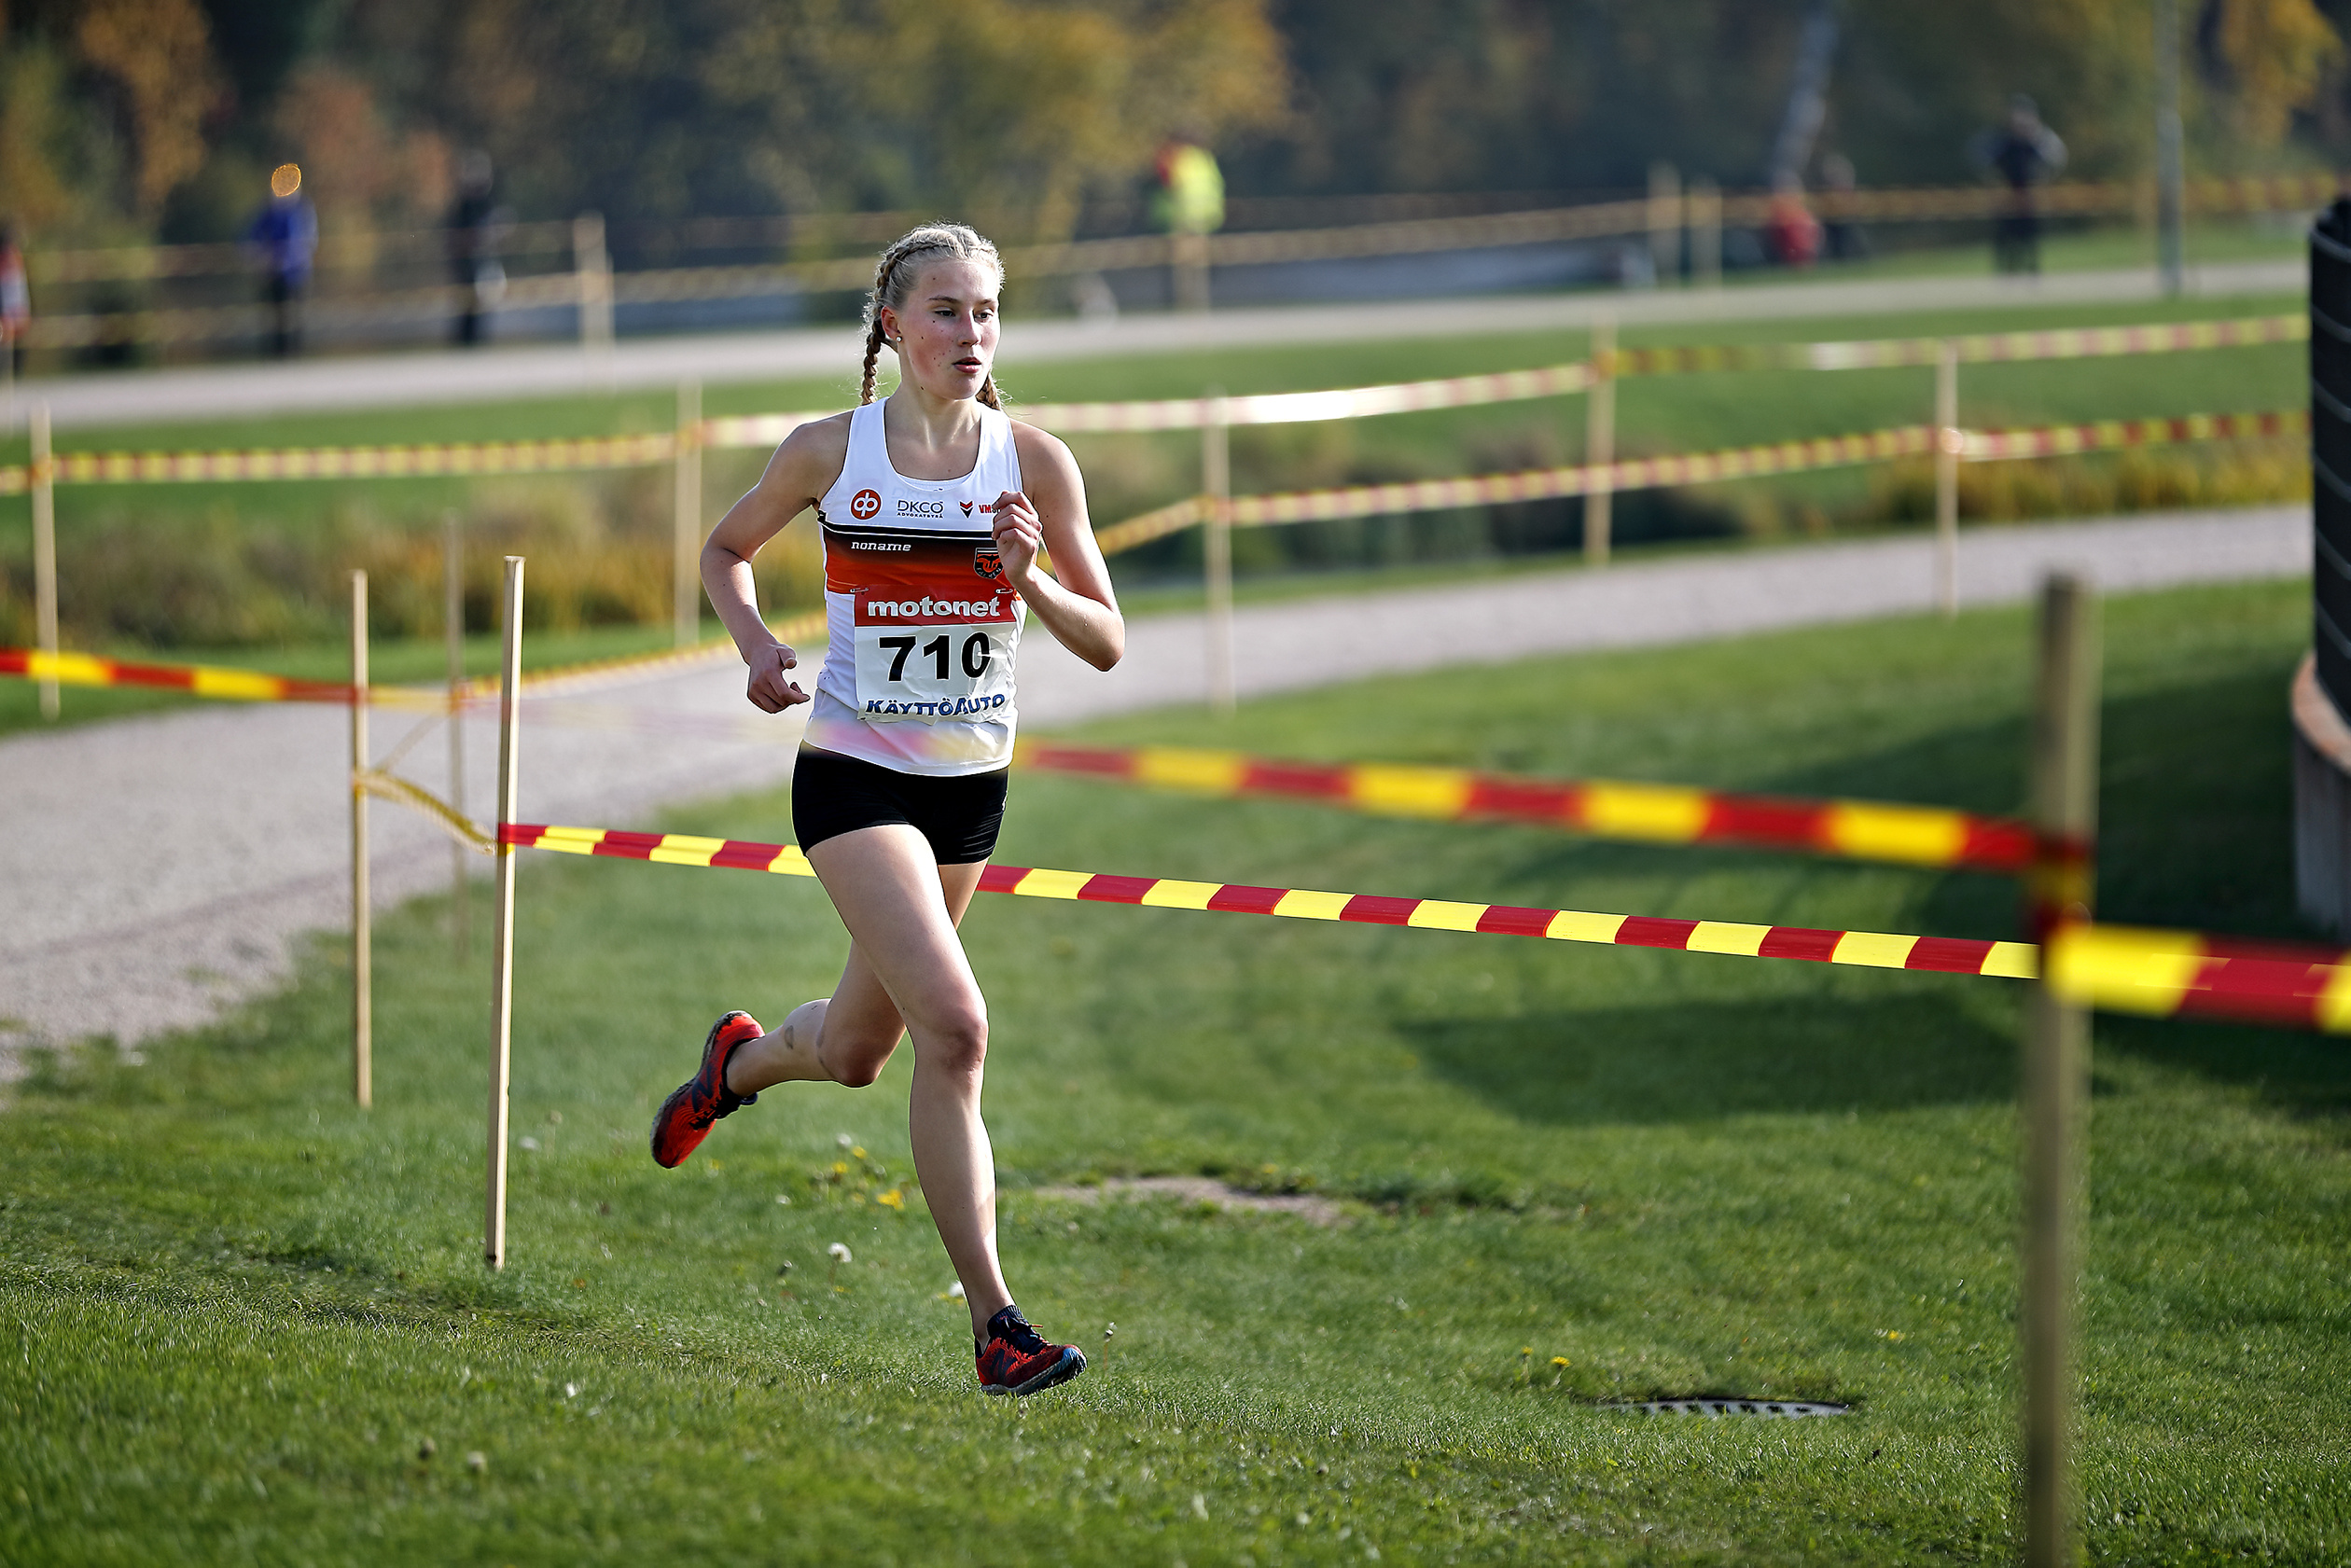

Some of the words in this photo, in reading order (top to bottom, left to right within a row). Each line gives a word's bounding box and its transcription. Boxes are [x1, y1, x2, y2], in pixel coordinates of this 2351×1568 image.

[851, 541, 911, 551] noname
[868, 595, 1001, 617] motonet
[879, 631, 991, 682] 710
